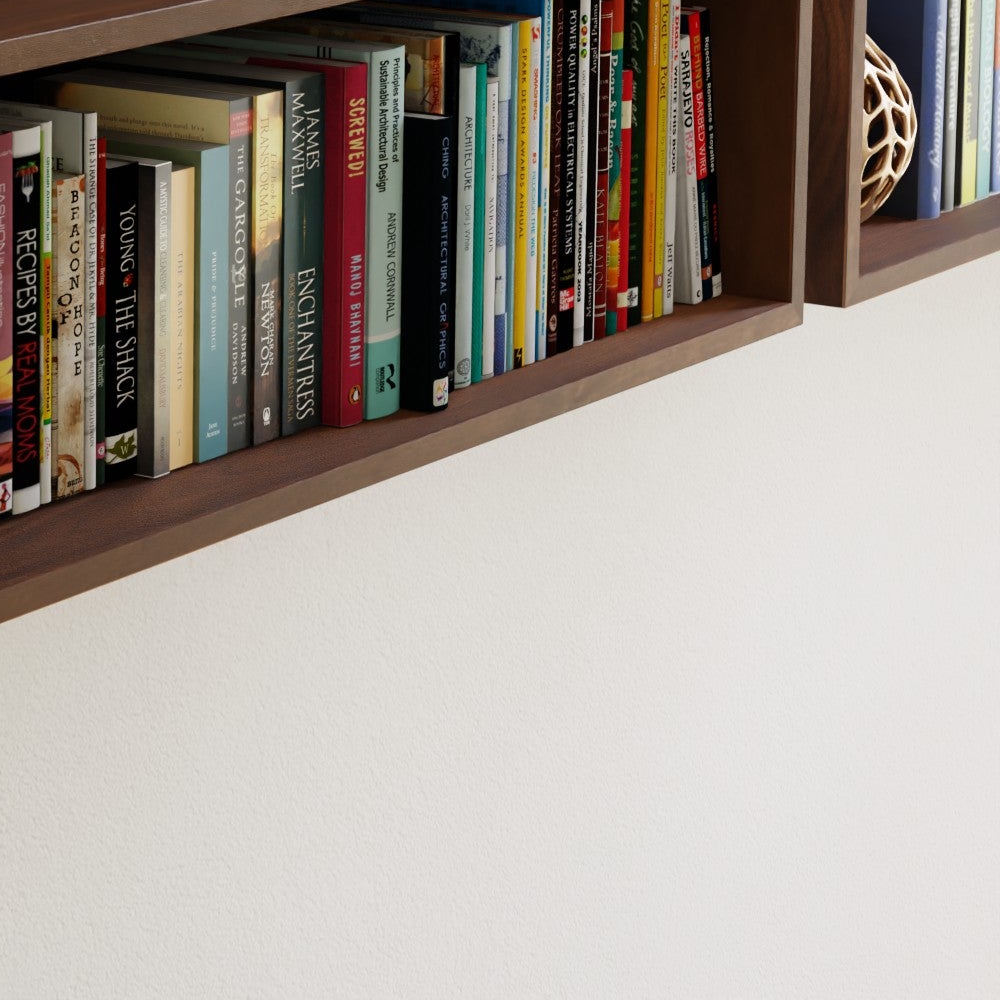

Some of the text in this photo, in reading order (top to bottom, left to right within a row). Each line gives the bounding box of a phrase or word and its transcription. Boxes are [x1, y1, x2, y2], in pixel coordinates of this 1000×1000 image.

[392, 58, 401, 96] Principles
[556, 9, 564, 105] CRUMBLED
[630, 20, 645, 52] God
[660, 3, 670, 101] Poet Poet
[291, 92, 306, 195] MAXWELL
[304, 109, 321, 170] JAMES
[348, 97, 366, 178] SCREWED!
[376, 60, 390, 193] Sustainable Architectural Design
[392, 115, 400, 152] Practices
[564, 10, 578, 256] POWER QUALITY in ELECTRICAL SYSTEMS
[681, 50, 696, 177] SARAJEVO ROSES
[693, 34, 708, 176] BEHIND BARBED WIRE
[704, 36, 712, 81] Rejection,
[708, 133, 716, 174] Royalties
[983, 66, 992, 153] BIOLOGY
[237, 144, 245, 174] THE
[270, 153, 278, 199] The Book
[392, 154, 400, 162] of
[463, 115, 474, 192] ARCHITECTURE
[88, 138, 97, 347] THE STRANGE CASE JEKYLL & HYDE
[159, 187, 168, 250] MYSTIC GUIDE TO
[231, 179, 246, 308] GARGOYLE
[438, 137, 450, 370] CHING ARCHITECTURAL GRAPHICS
[488, 197, 497, 253] NAVIGATION
[551, 209, 560, 255] Patricia
[595, 188, 606, 293] KATE BEATON
[58, 190, 83, 377] BEACON OF HOPE
[115, 204, 137, 408] YOUNG THE SHACK
[287, 272, 296, 297] BOOK
[385, 212, 397, 322] ANDREW CORNWALL
[665, 242, 675, 300] Jeff Watts
[16, 228, 38, 463] RECIPES BY REAL MOMS
[98, 344, 106, 357] Sue
[260, 281, 271, 377] NEWTON
[287, 300, 296, 319] ONE
[287, 338, 296, 354] THE
[288, 322, 296, 335] OF
[296, 267, 316, 420] ENCHANTRESS
[349, 254, 363, 368] MANOJ BHAVNANI
[232, 322, 240, 384] DAVIDSON
[287, 397, 295, 423] SAGA
